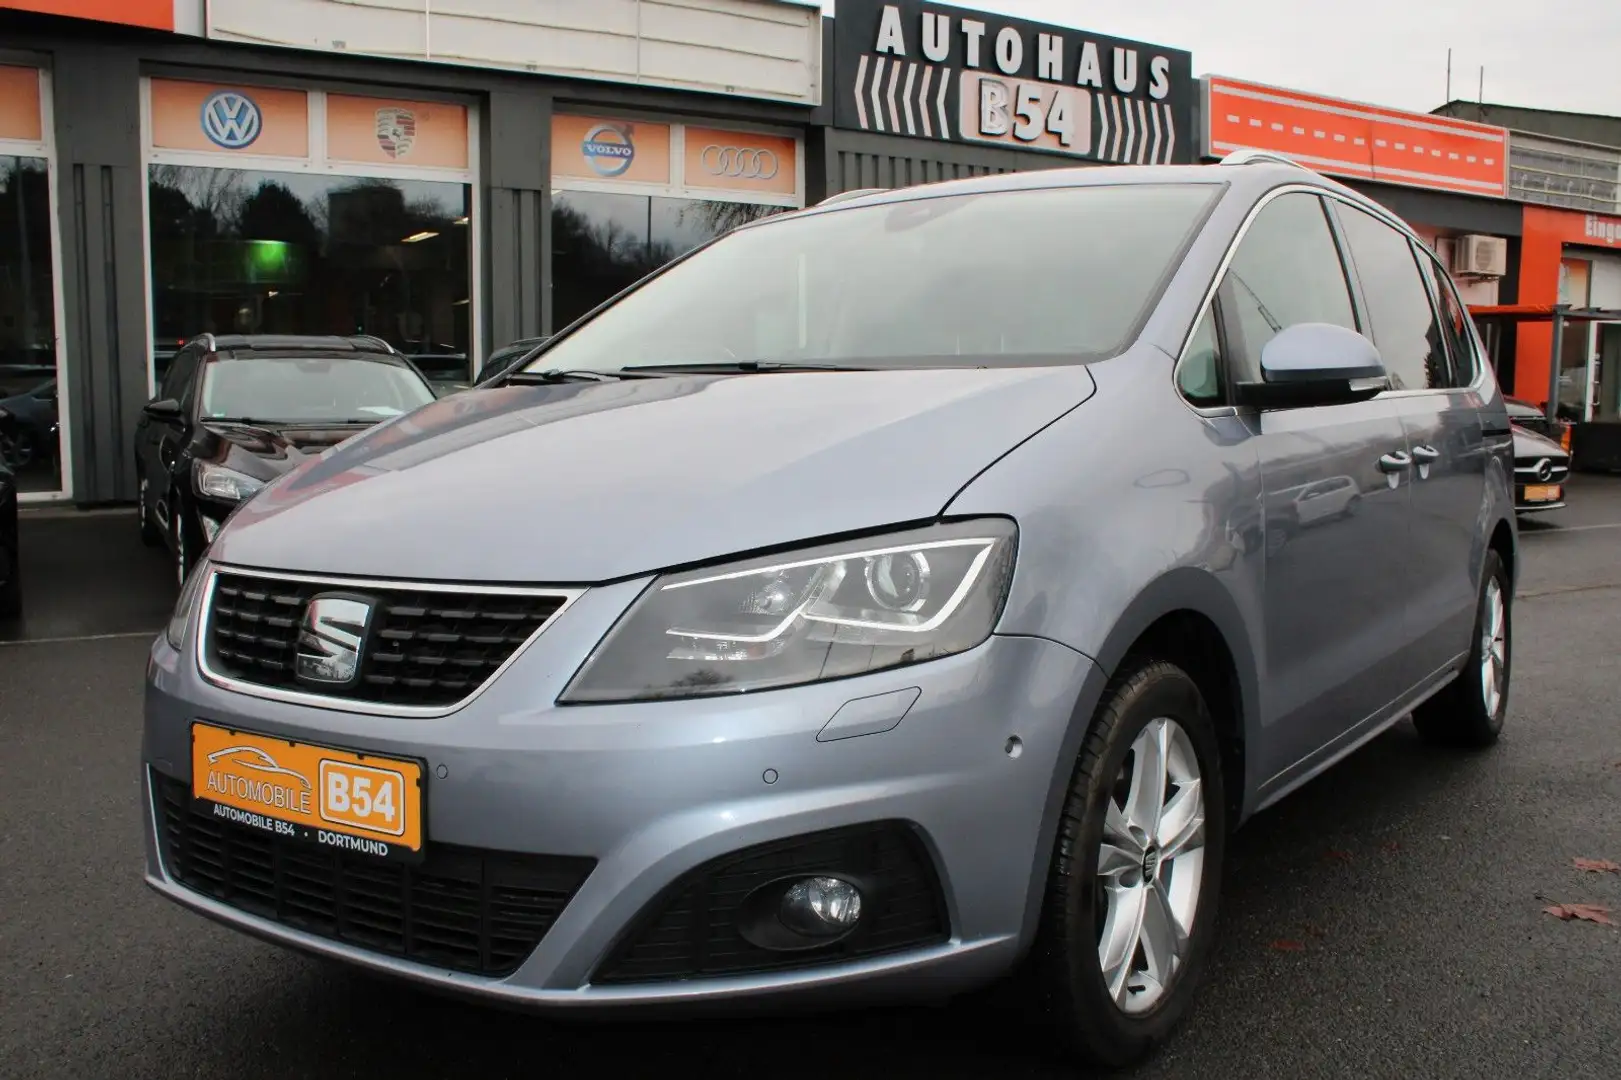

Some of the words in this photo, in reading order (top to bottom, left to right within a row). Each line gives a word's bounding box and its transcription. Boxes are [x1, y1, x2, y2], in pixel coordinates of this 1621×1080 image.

[876, 5, 1170, 100] AUTOHAUS
[979, 77, 1075, 147] B54
[585, 144, 632, 156] VOLVO
[208, 770, 312, 815] AUTOMOBILE
[327, 772, 395, 823] B54
[213, 803, 273, 831] AUTOMOBILE
[275, 822, 296, 837] B54
[318, 830, 388, 857] DORTMUND
